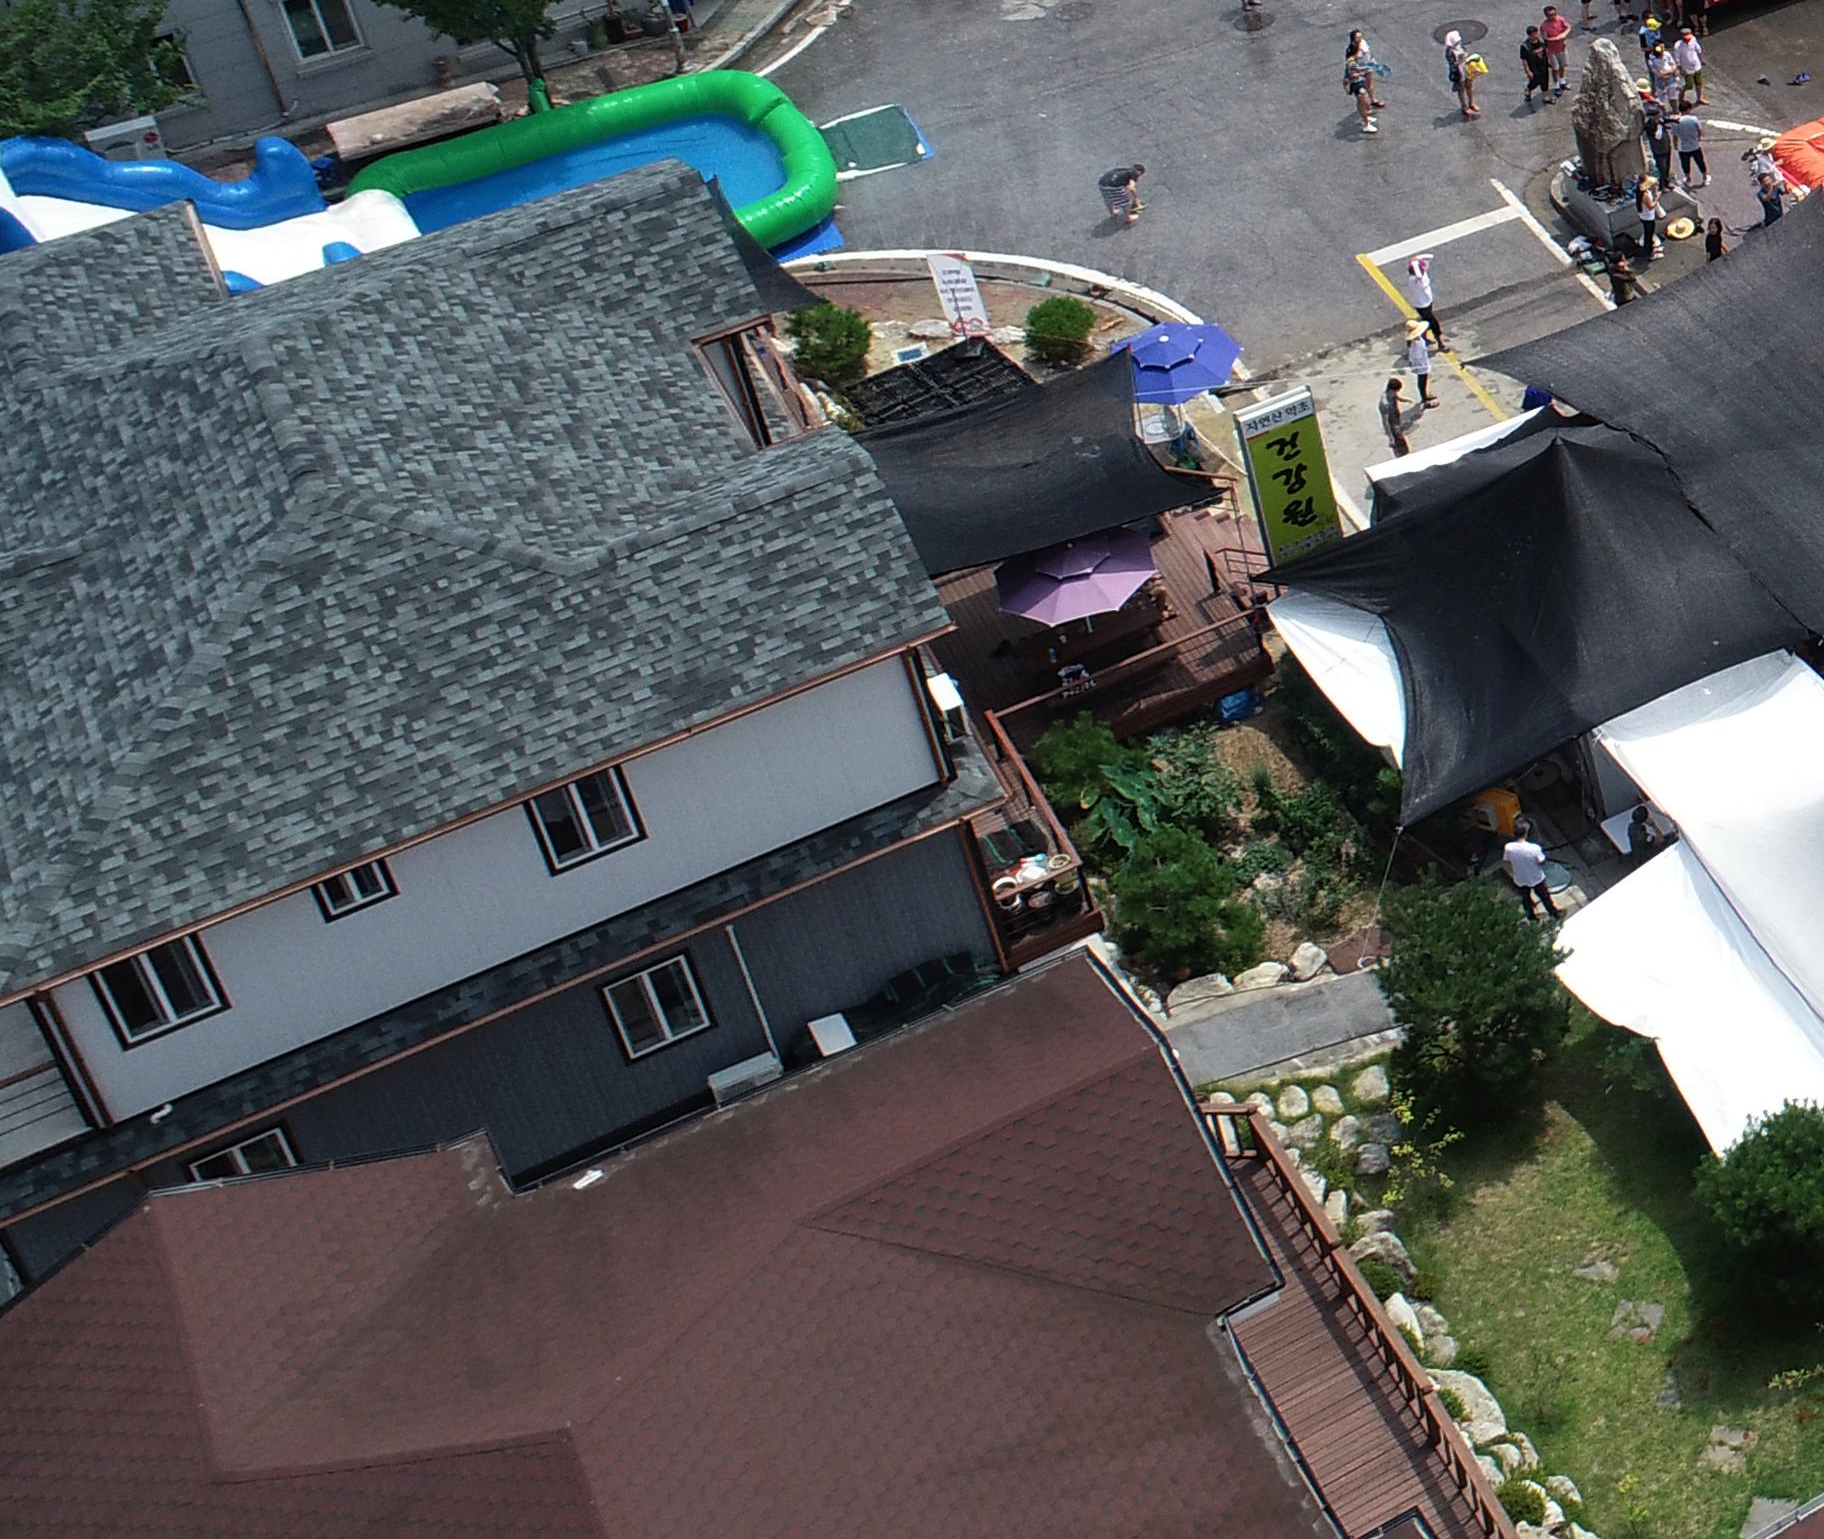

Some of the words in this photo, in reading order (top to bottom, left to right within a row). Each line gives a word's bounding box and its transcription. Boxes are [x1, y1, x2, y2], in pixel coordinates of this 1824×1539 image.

[1245, 412, 1283, 433] 자연산
[1284, 401, 1311, 418] 약초
[1266, 430, 1318, 528] 건강원
